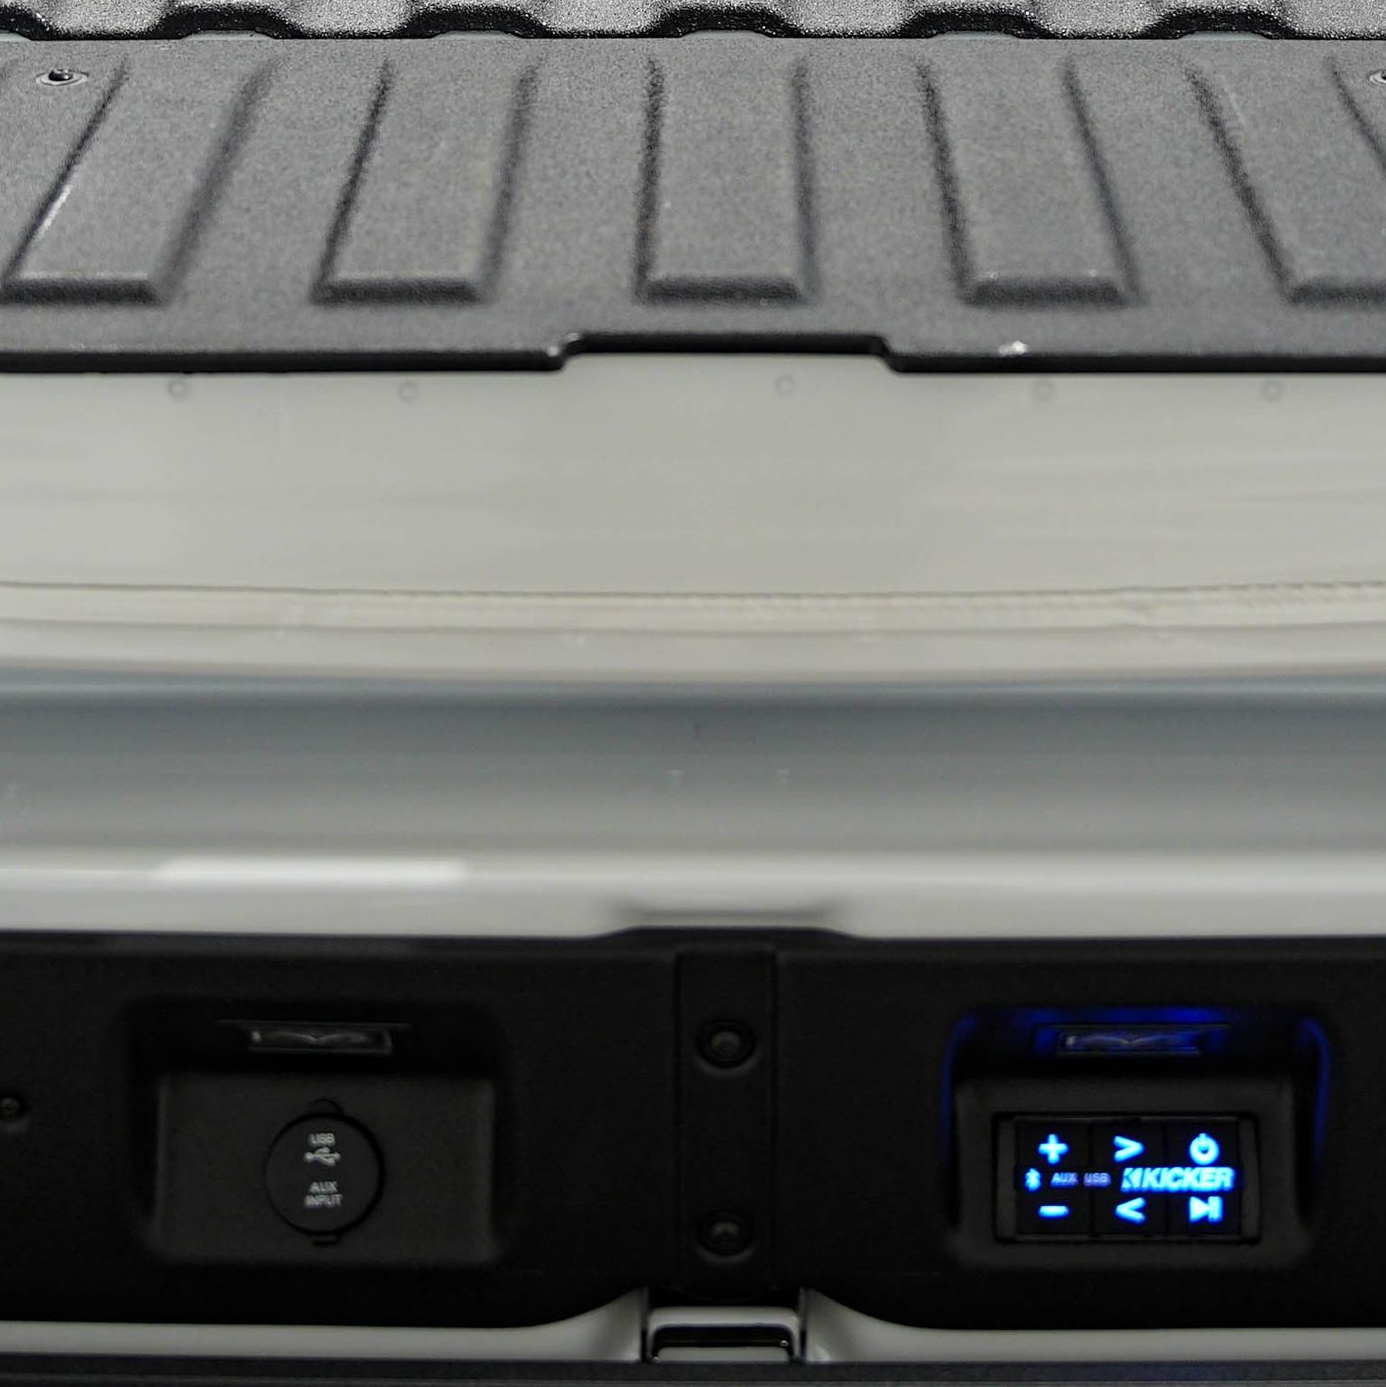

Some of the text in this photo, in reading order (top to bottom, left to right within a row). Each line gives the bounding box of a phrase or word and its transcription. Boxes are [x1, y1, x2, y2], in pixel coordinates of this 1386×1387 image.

[309, 1133, 335, 1146] USB
[1051, 1167, 1235, 1190] AUX USB KICKER
[310, 1181, 338, 1193] AUX
[305, 1194, 342, 1207] INPUT
